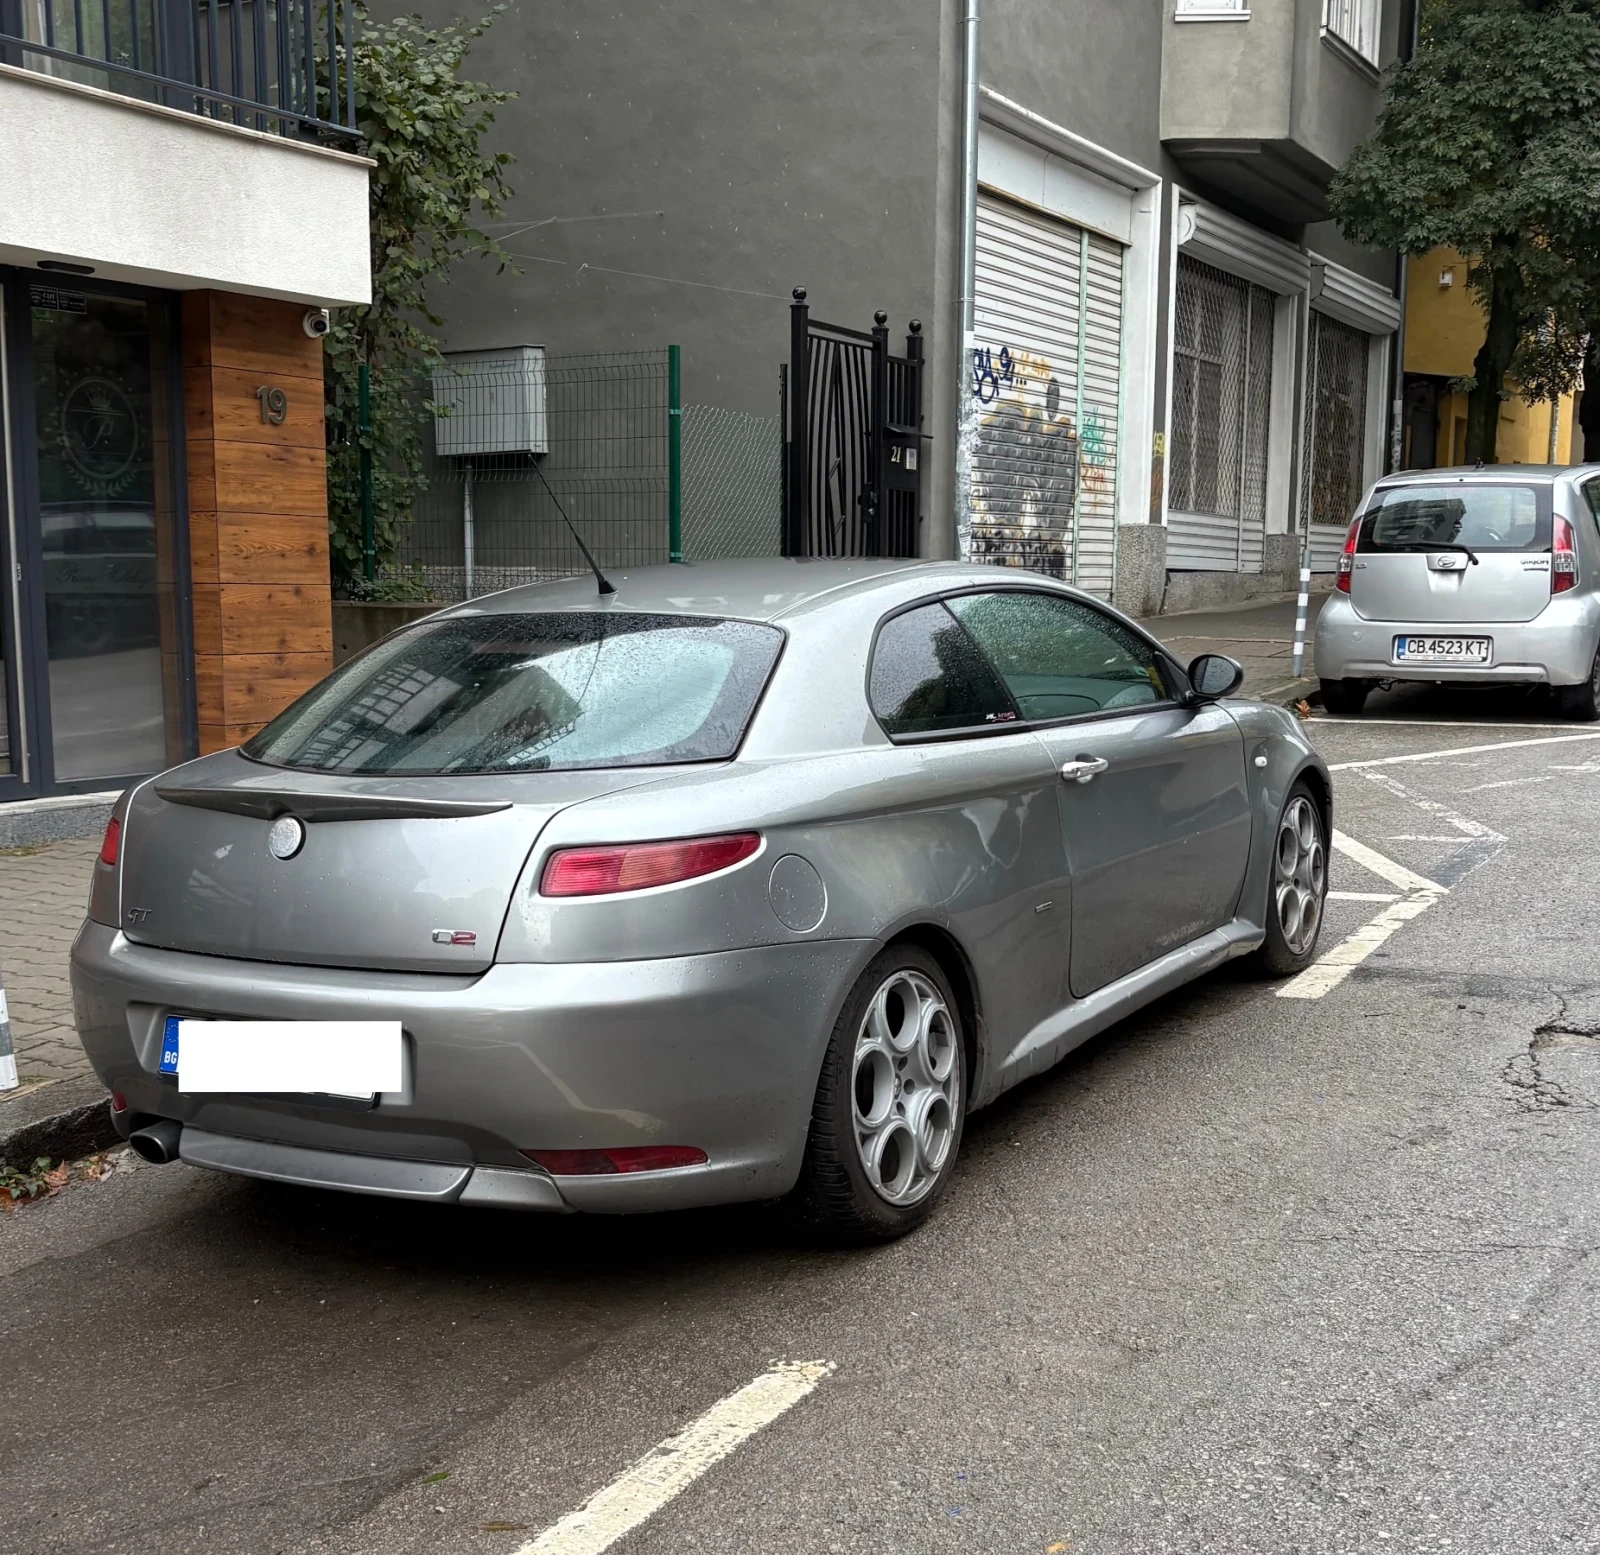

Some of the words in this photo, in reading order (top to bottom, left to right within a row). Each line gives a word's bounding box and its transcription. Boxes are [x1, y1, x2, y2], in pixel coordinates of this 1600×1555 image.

[257, 385, 287, 424] 19
[890, 445, 901, 463] 21
[128, 907, 153, 923] GT
[431, 929, 476, 945] Q2
[164, 1050, 178, 1064] BG
